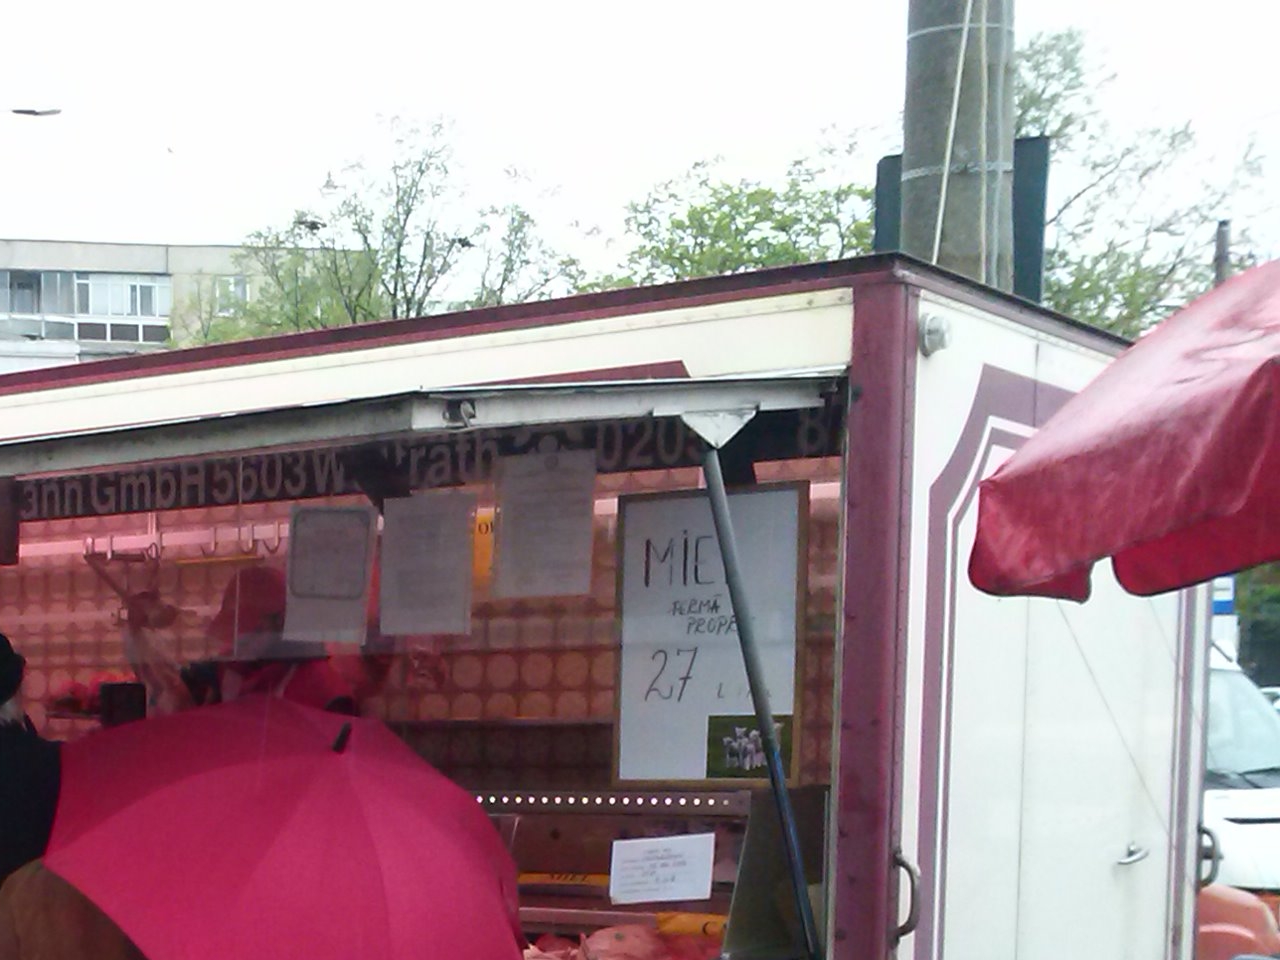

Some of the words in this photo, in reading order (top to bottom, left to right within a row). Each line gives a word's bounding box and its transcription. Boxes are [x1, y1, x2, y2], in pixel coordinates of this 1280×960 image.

[90, 461, 205, 514] GmbH
[213, 452, 307, 507] 5603
[644, 646, 699, 702] 27
